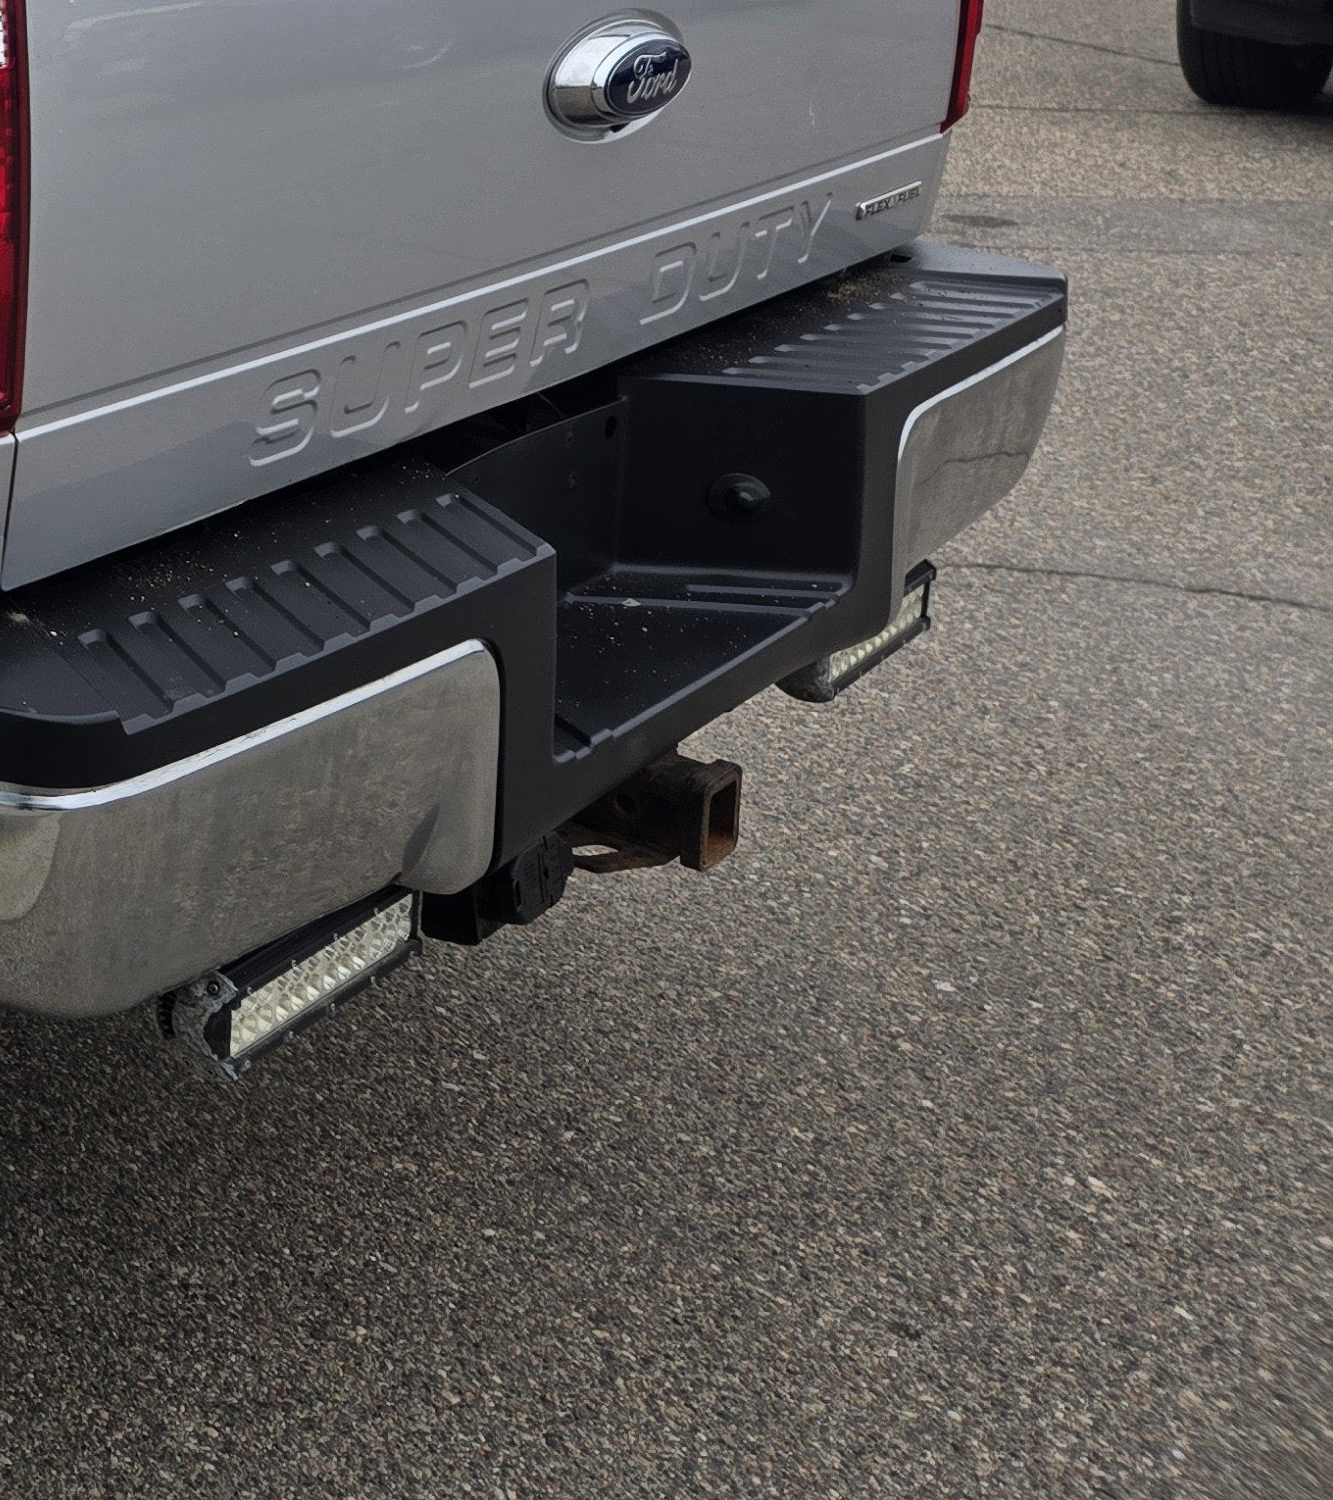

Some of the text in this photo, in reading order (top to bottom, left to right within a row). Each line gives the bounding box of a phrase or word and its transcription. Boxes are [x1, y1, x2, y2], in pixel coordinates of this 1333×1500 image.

[627, 54, 678, 105] Ford
[864, 186, 921, 217] FLEX FUEL
[248, 192, 835, 469] SUPER DUTY
